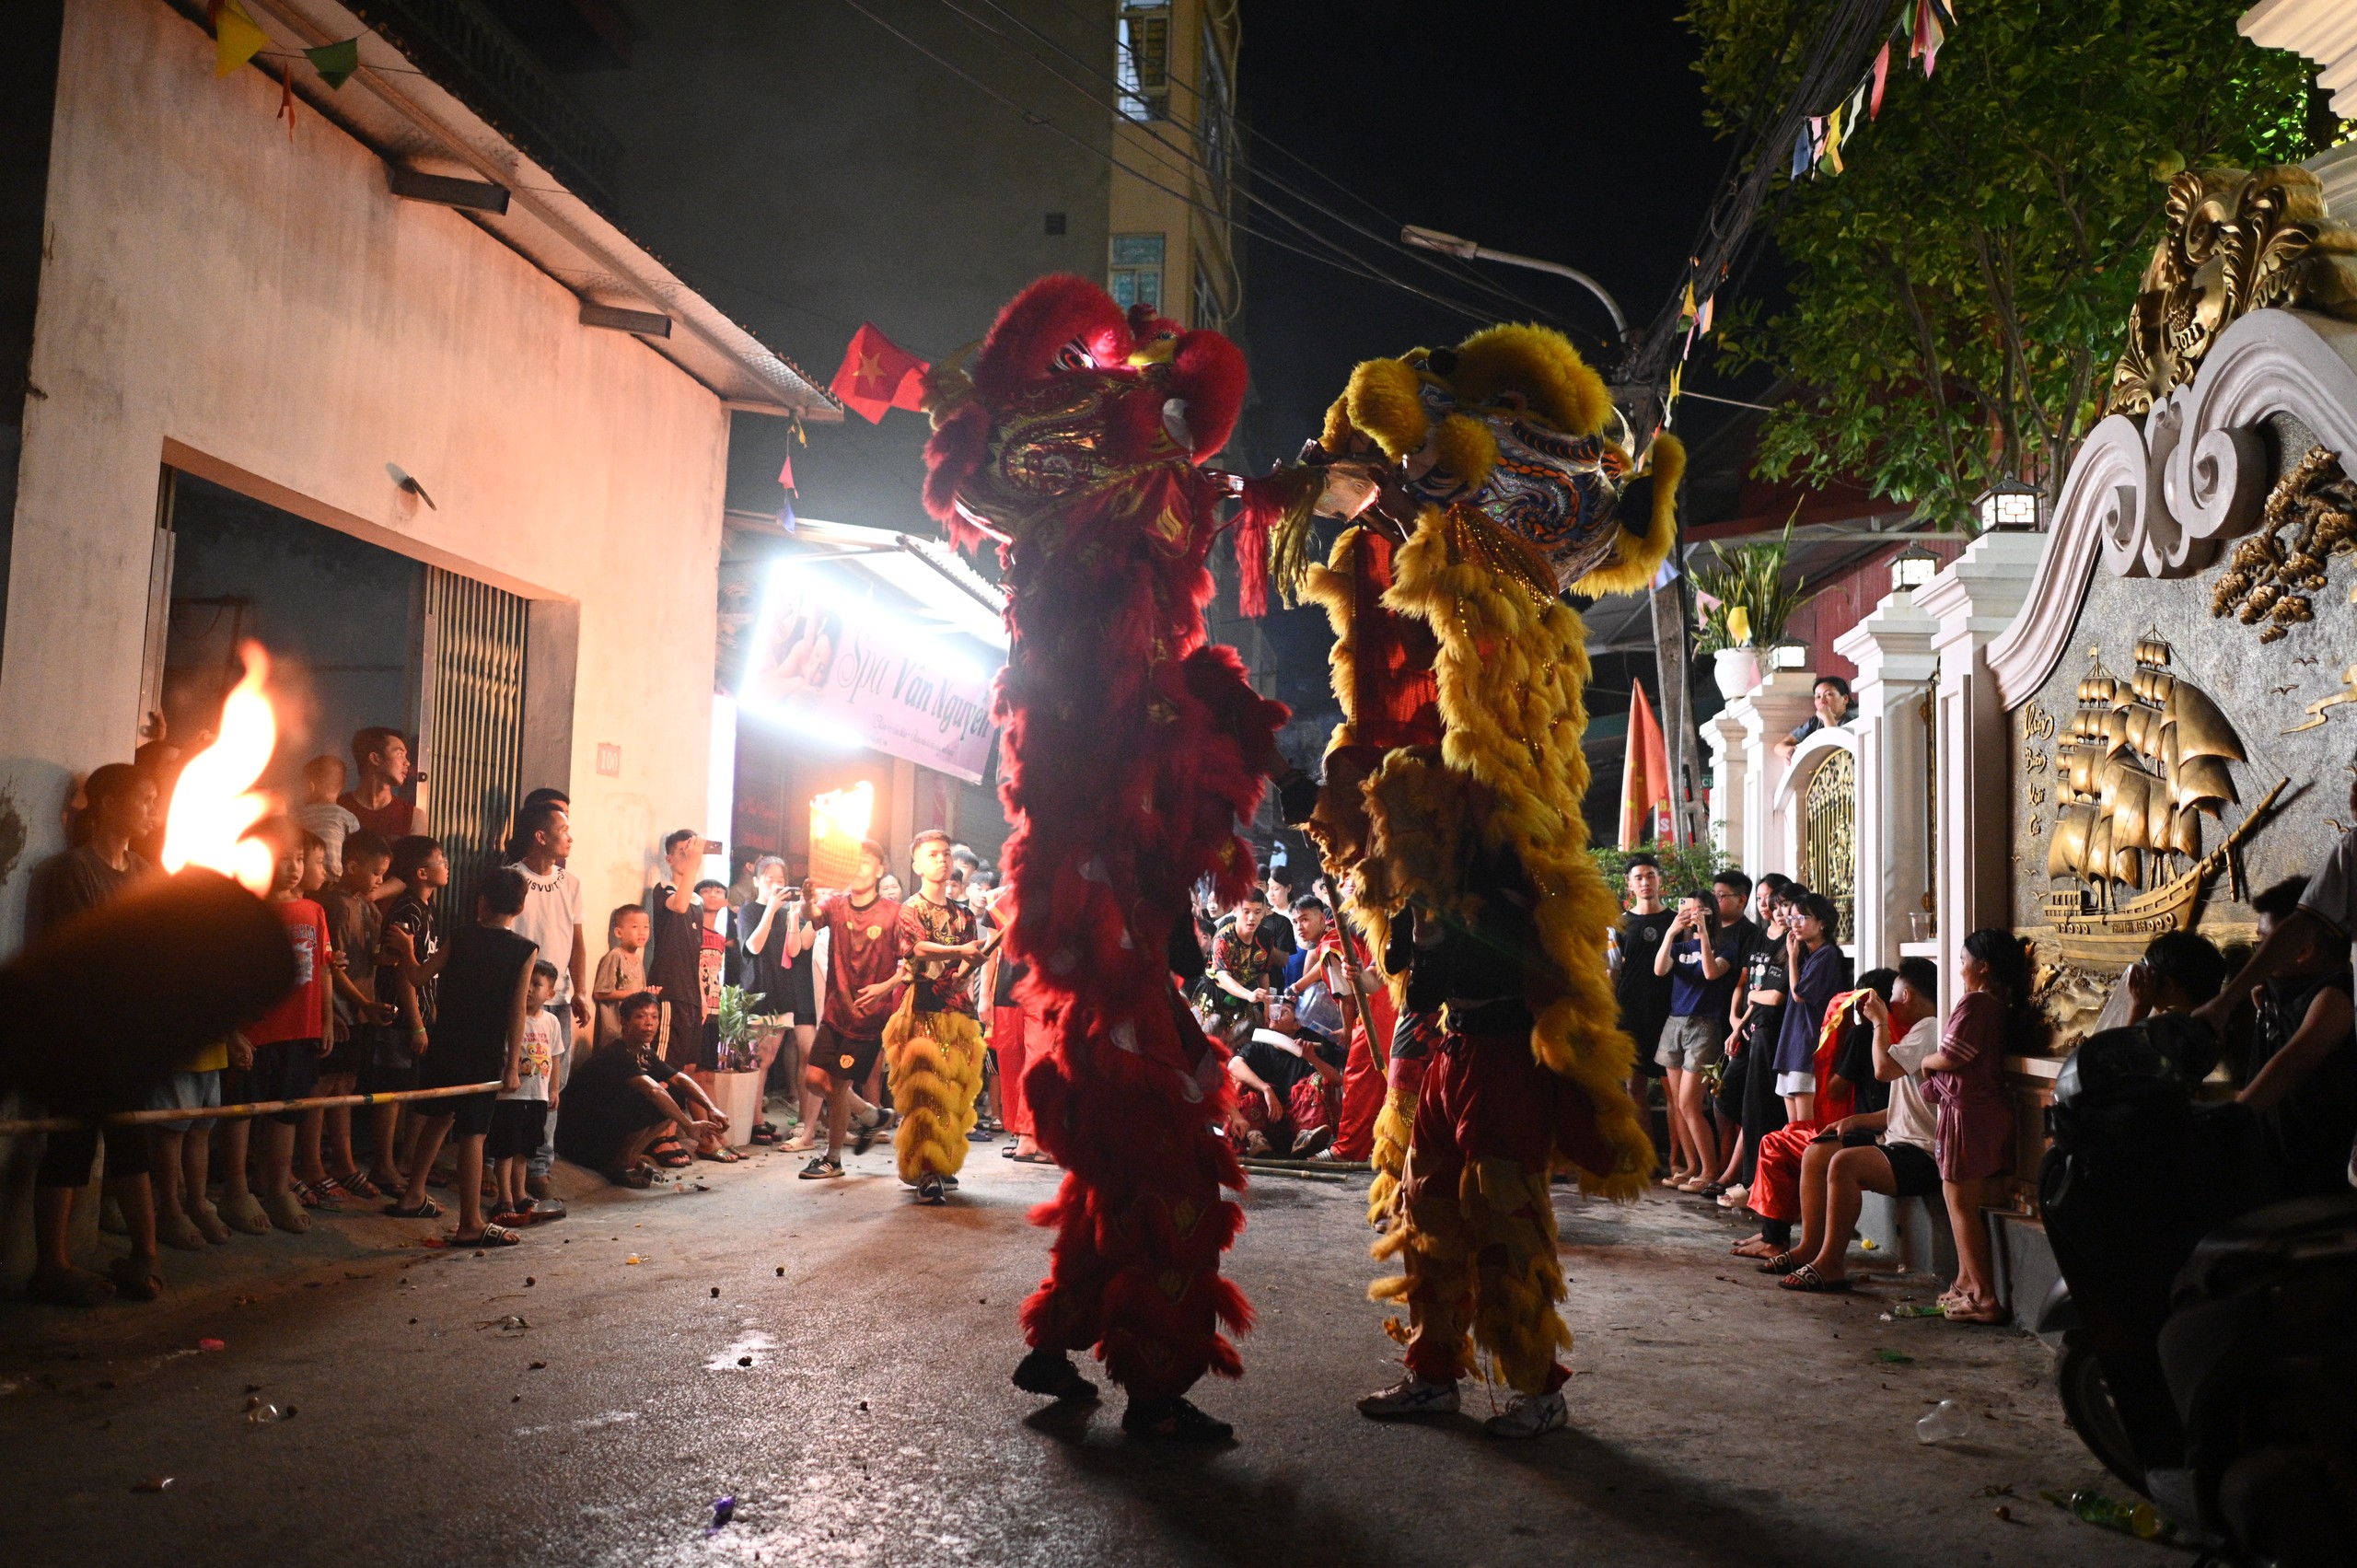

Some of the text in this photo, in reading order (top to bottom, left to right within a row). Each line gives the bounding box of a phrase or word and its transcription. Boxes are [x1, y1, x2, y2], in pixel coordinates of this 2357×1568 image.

[838, 631, 890, 704] Spa
[892, 656, 935, 713] Vân
[600, 749, 619, 772] 100
